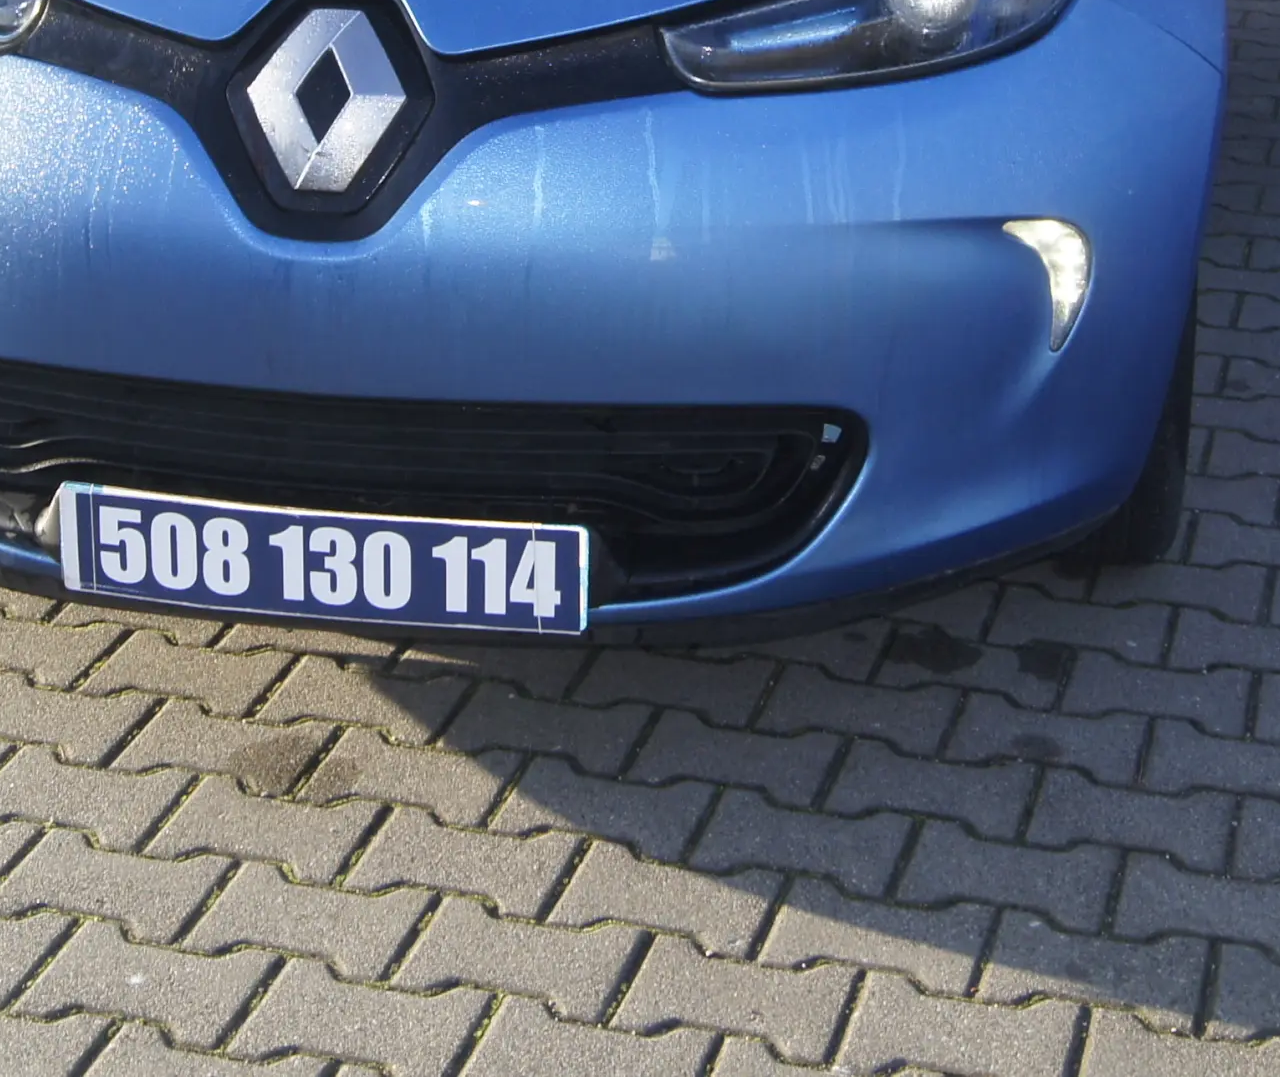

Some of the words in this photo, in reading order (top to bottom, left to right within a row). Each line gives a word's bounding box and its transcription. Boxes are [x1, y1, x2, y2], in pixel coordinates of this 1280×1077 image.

[96, 506, 252, 599] 508
[267, 523, 414, 611] 130
[430, 536, 562, 618] 114
